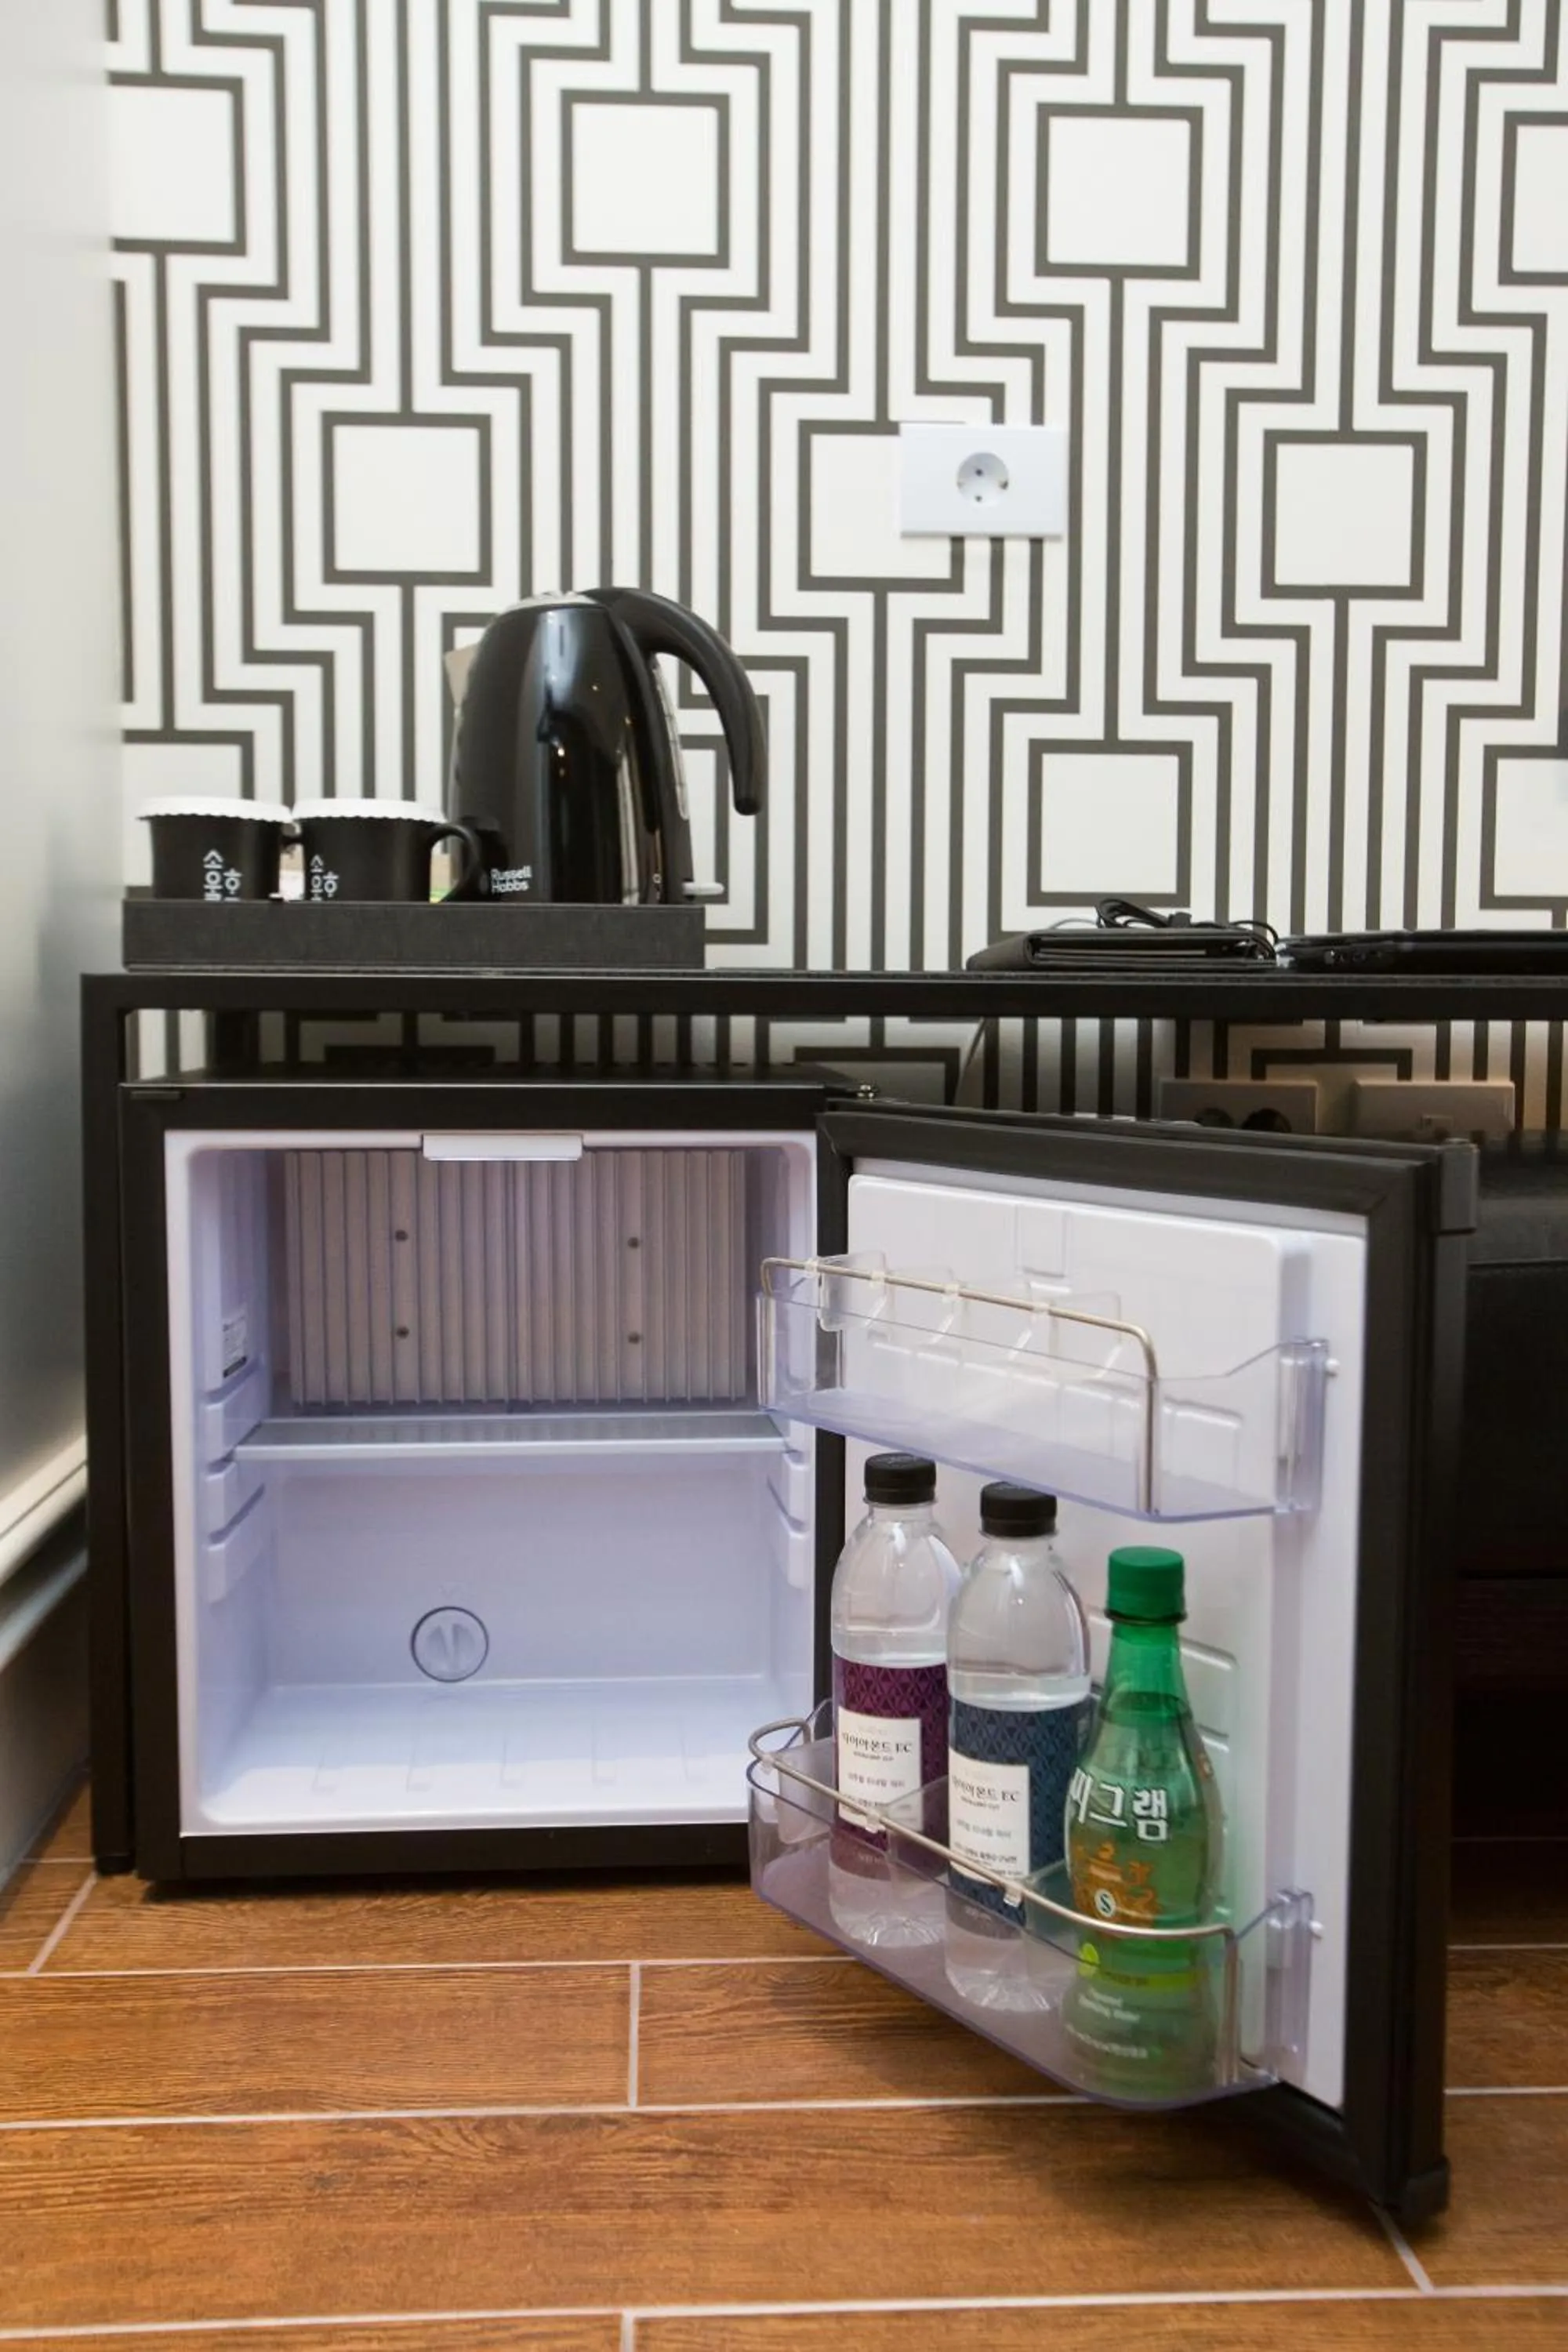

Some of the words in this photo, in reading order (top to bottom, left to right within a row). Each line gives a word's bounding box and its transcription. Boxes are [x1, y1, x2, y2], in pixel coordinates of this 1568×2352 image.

[491, 866, 532, 879] Russell
[491, 877, 530, 894] Hobbs
[841, 1731, 892, 1753] 다이아몬드
[895, 1741, 913, 1755] EC
[1000, 1790, 1020, 1802] EC
